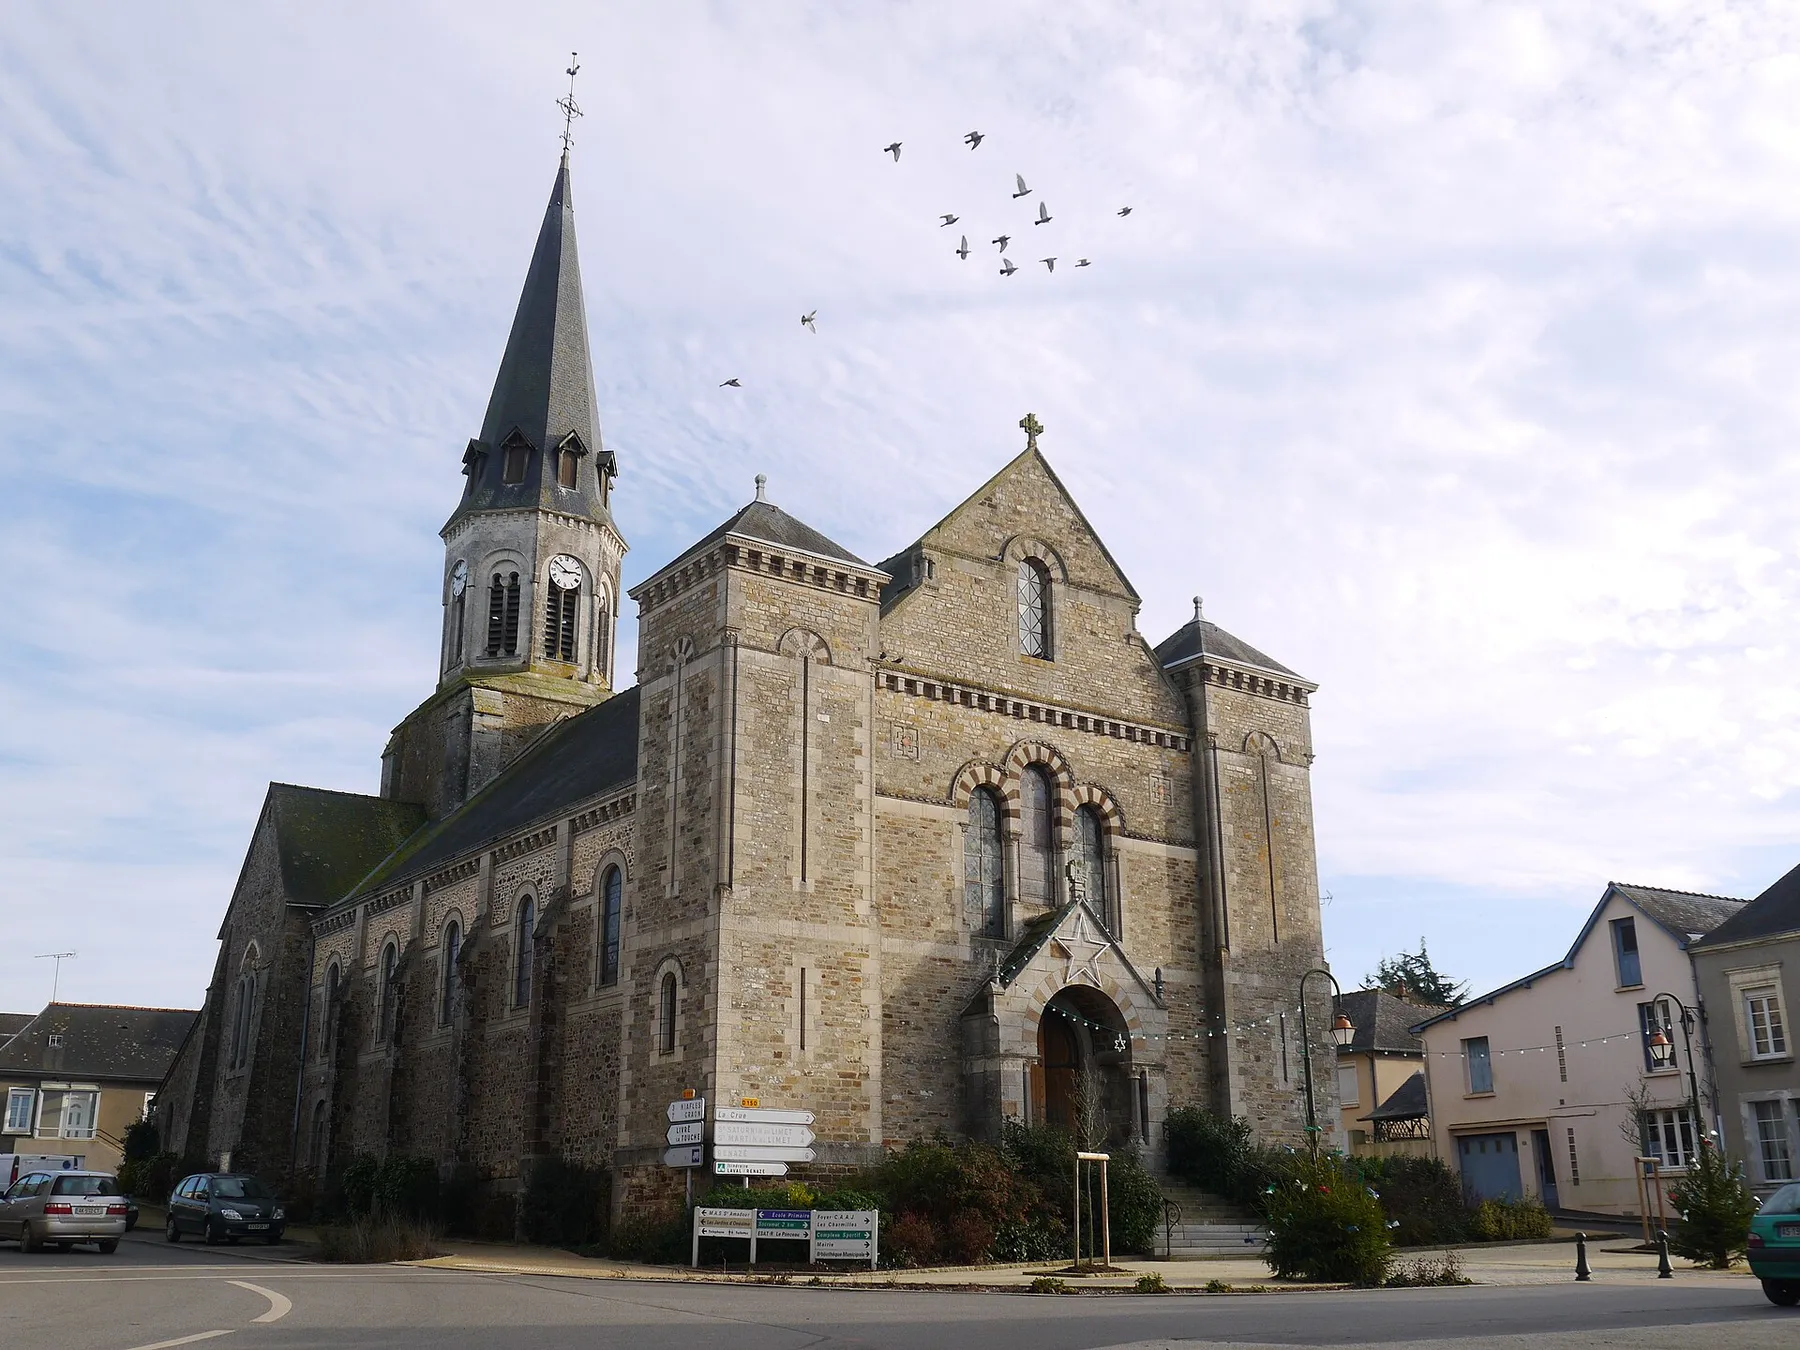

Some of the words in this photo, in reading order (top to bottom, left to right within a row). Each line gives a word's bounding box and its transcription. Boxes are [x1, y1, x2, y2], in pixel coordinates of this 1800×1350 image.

[726, 1126, 763, 1135] SATURNIN
[771, 1128, 793, 1136] LIMET
[681, 1133, 700, 1142] TOUCHE
[727, 1135, 759, 1143] MARTIN
[767, 1136, 791, 1144] LIMET
